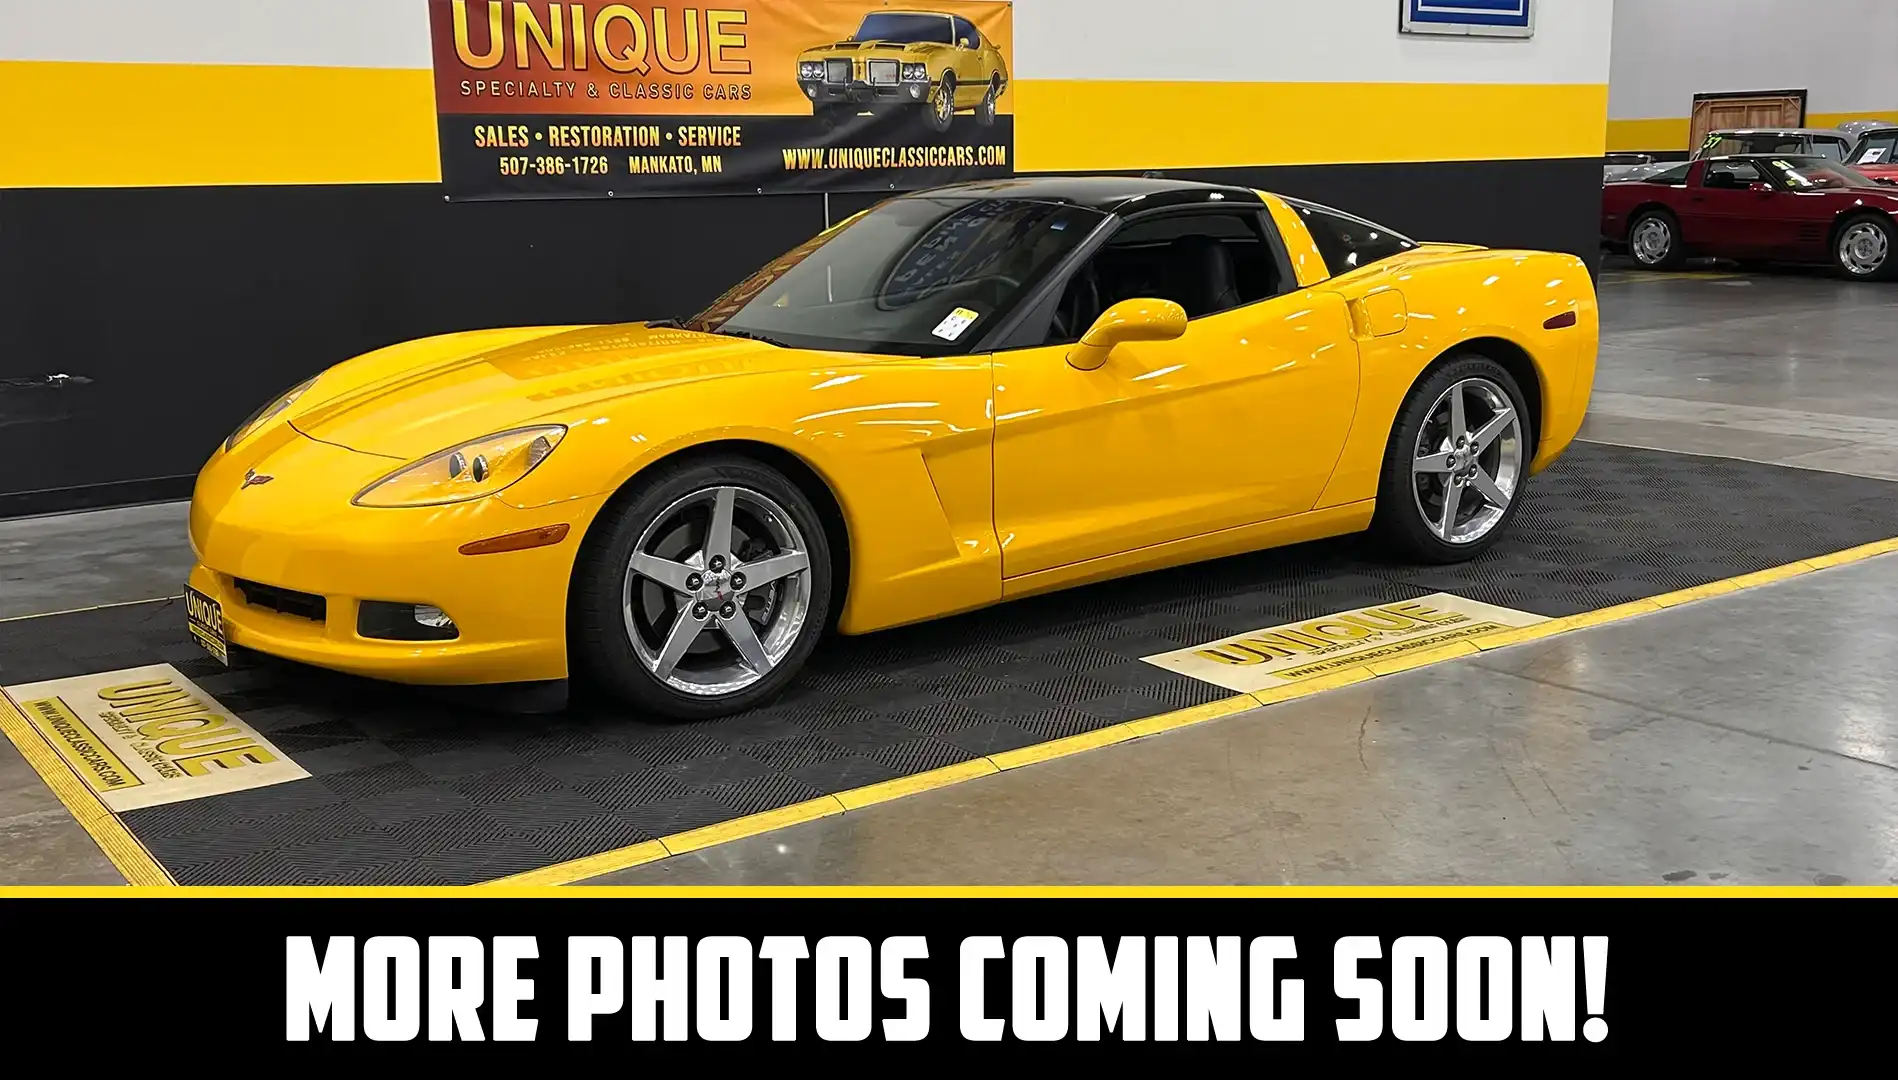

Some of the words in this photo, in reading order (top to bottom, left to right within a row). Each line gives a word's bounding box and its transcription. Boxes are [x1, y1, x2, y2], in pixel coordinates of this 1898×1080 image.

[452, 0, 752, 76] UNIQUE
[460, 80, 576, 98] SPECIALTY
[587, 82, 599, 98] &
[609, 82, 694, 99] CLASSIC
[703, 84, 752, 99] CARS
[474, 125, 529, 148] SALES
[549, 125, 660, 147] RESTORATION
[678, 125, 741, 147] SERVICE
[782, 145, 1007, 171] WWW.UNIQUECLASSICCARS.COM
[500, 156, 608, 175] 507-386-1726
[628, 155, 698, 175] MANKATO,
[702, 155, 722, 173] MN
[185, 590, 223, 634] UNIQUE
[1196, 600, 1465, 667] UNIQUE
[1283, 623, 1500, 678] WWW.UNIQUECLASSICCARS.COM
[34, 701, 127, 788] WWW.UNIQUECLASSICCARS.COM
[97, 677, 280, 777] UNIQUE
